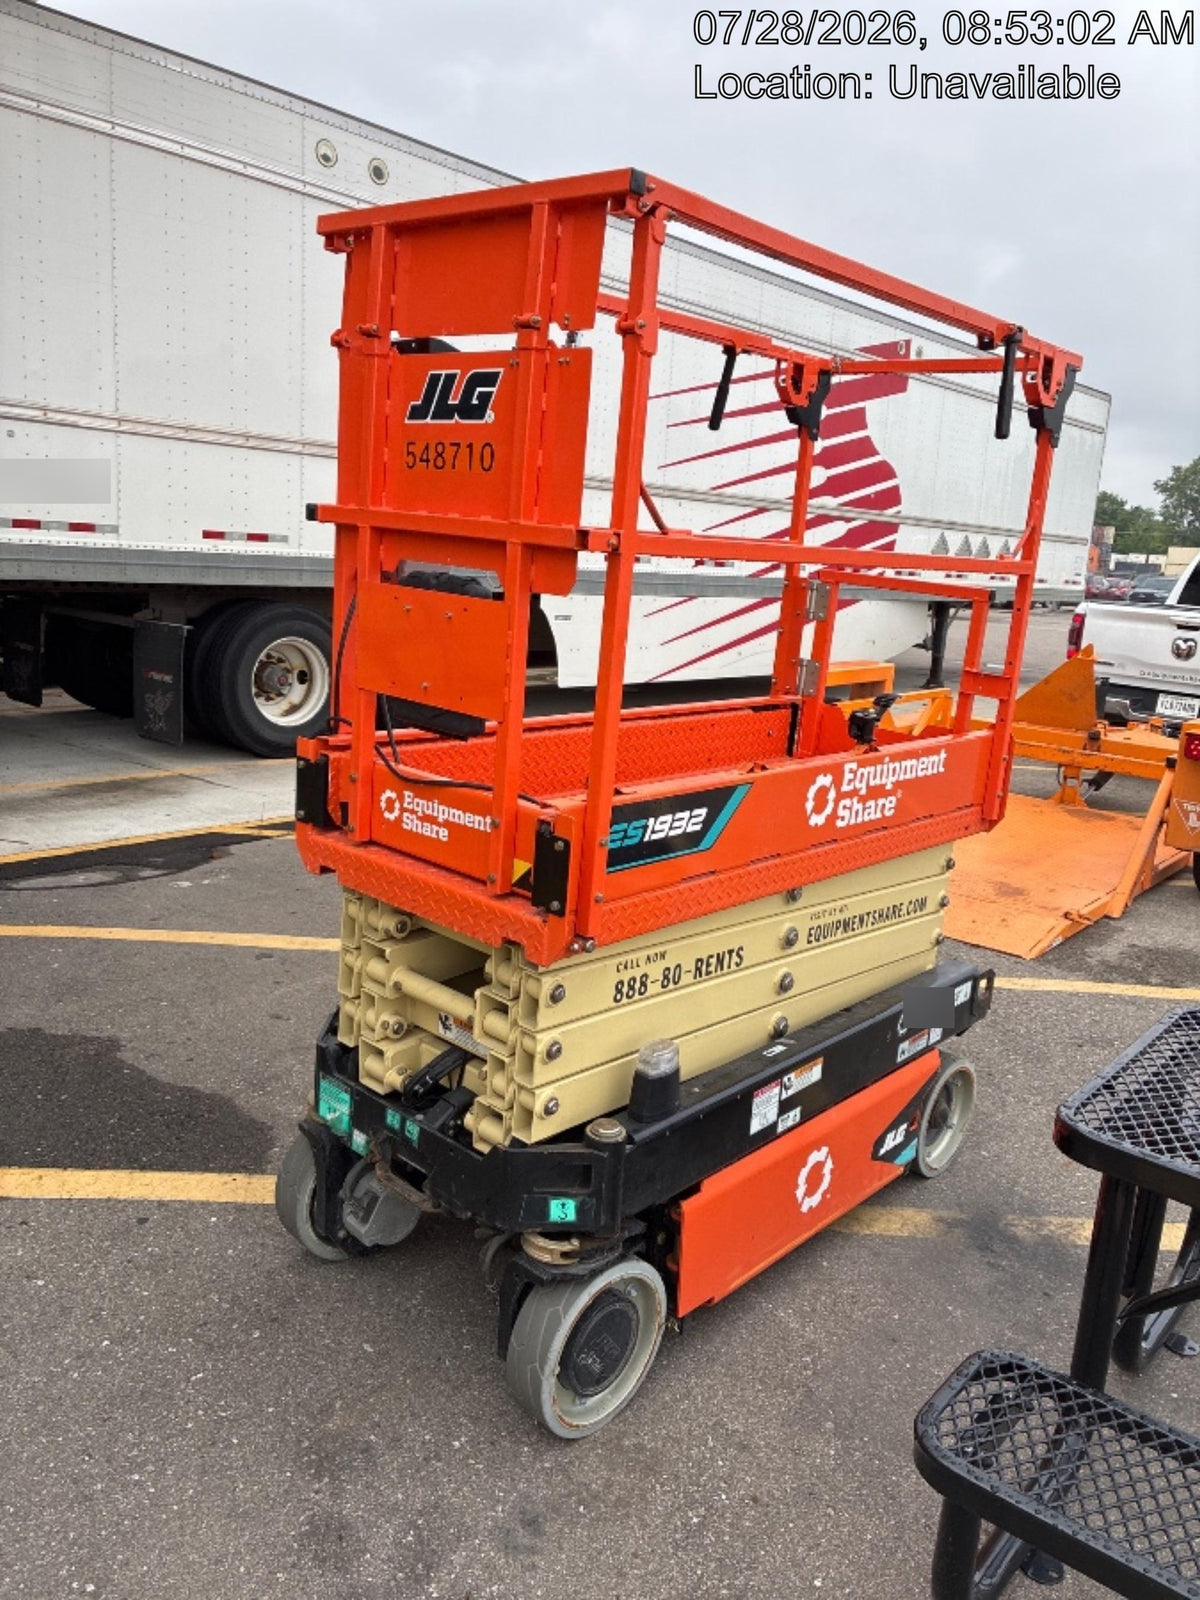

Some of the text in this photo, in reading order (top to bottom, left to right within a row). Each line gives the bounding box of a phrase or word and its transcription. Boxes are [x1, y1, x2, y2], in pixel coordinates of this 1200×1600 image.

[404, 368, 504, 424] JLG
[405, 441, 495, 472] 548710
[840, 749, 947, 795] Equipment
[402, 790, 492, 833] Equipment
[402, 812, 449, 842] Share
[608, 806, 709, 849] ES1932
[835, 795, 897, 828] Share
[806, 896, 928, 945] EQUIPMENTSHARE.COM
[613, 945, 744, 1004] 888-80-RENTS
[616, 950, 667, 973] CALL NOW
[878, 1121, 909, 1157] JLG
